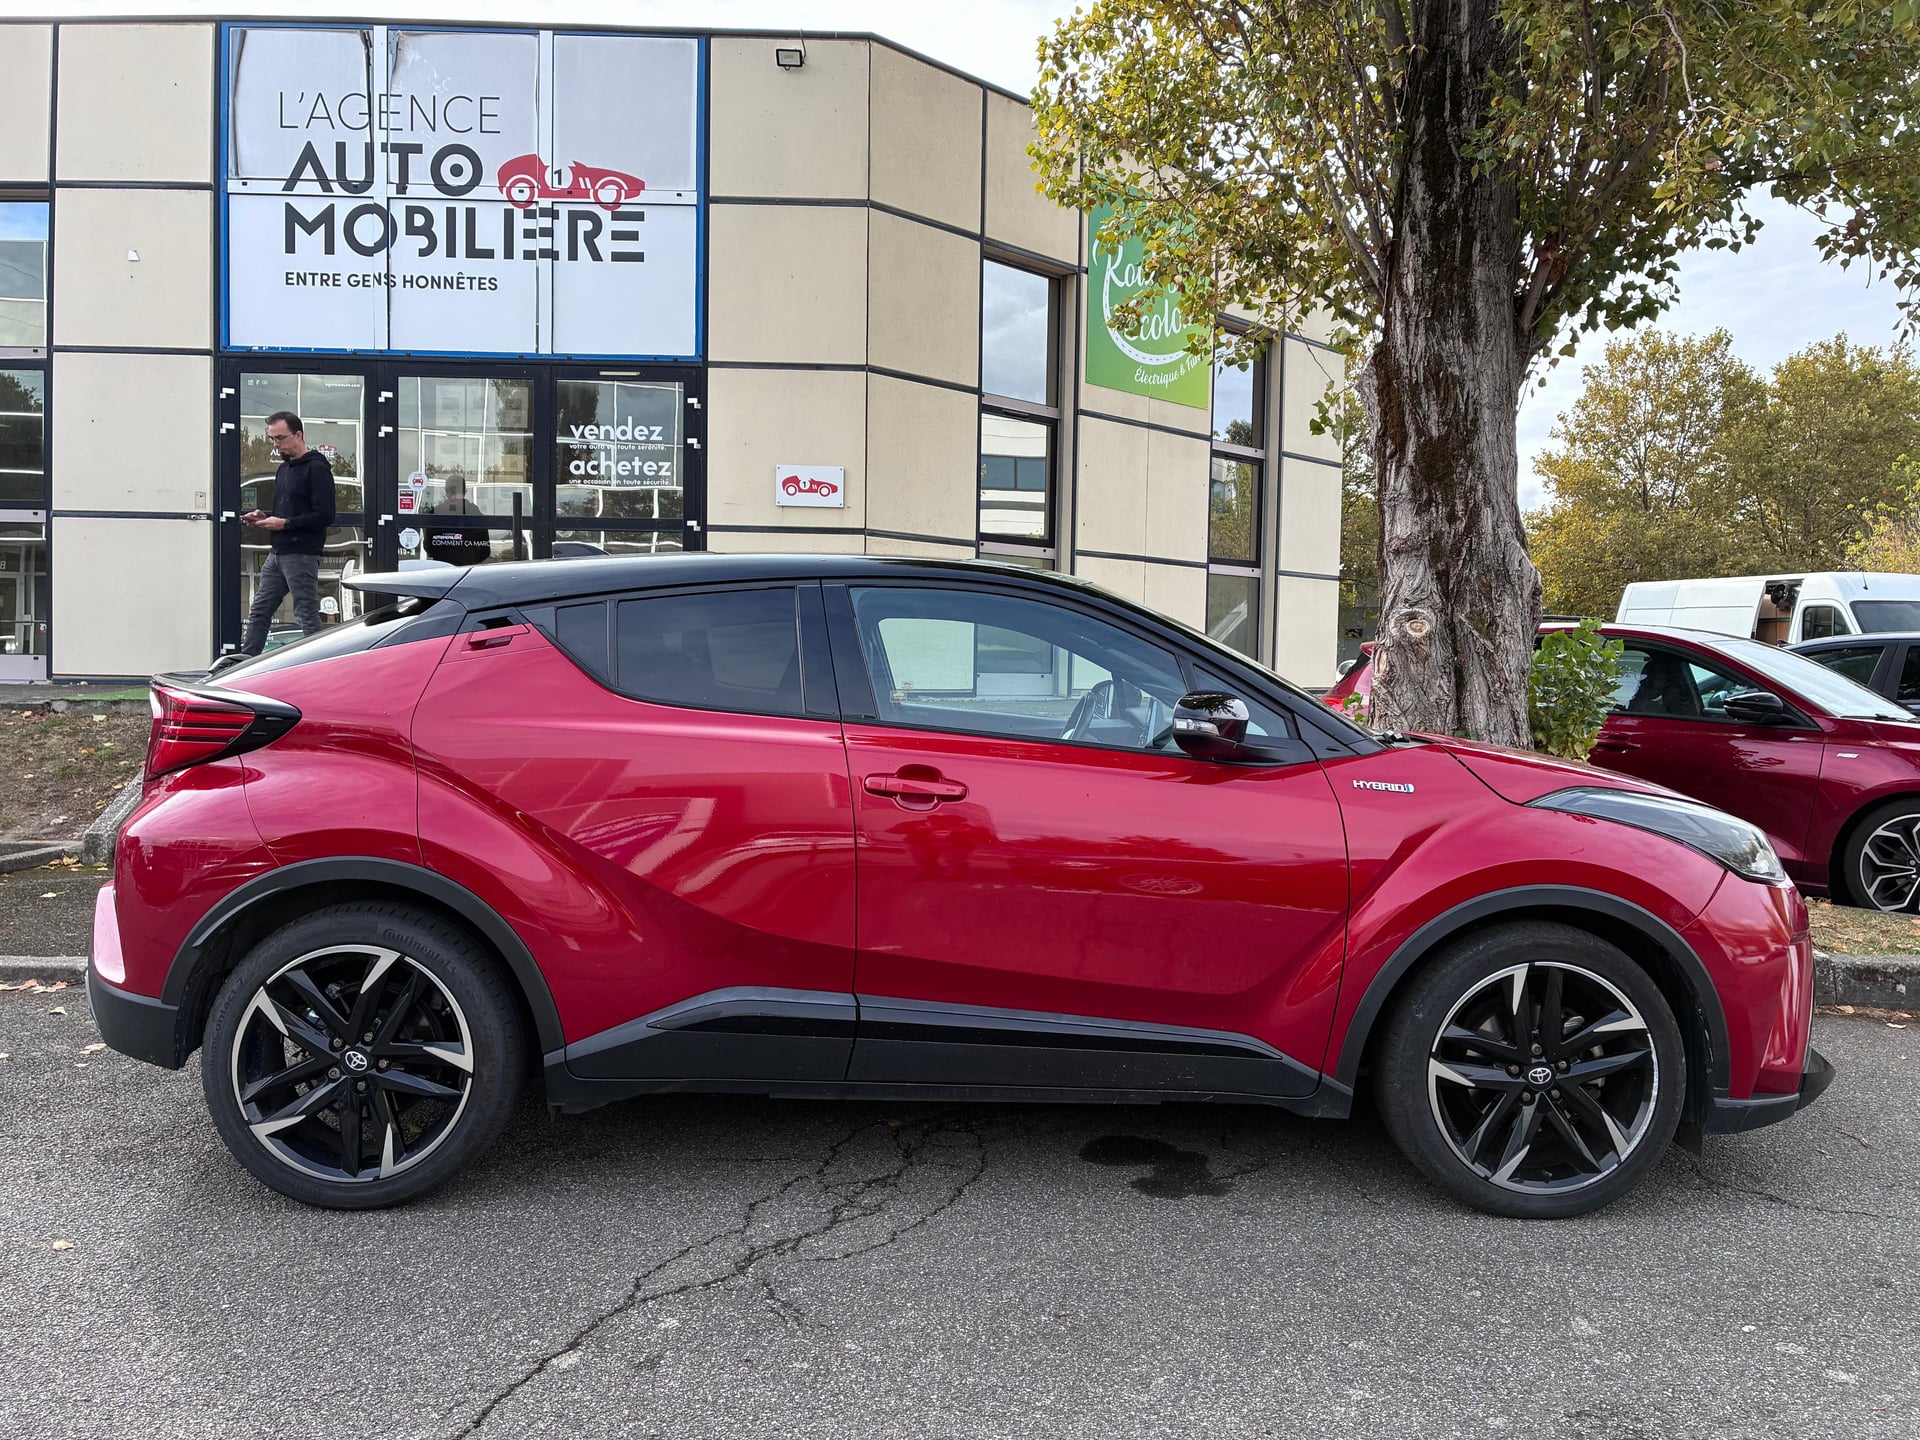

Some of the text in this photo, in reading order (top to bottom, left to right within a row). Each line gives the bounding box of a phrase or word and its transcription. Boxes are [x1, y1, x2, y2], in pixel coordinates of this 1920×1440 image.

[279, 91, 501, 134] L'AGENCE
[281, 140, 483, 197] AUTO
[284, 202, 645, 263] MOBILIERE
[285, 272, 498, 292] ENTRE GENS HONNÊTES
[1134, 366, 1179, 389] Électrique
[1179, 363, 1186, 376] &
[569, 415, 663, 441] vendez
[617, 443, 636, 451] toute
[569, 451, 672, 476] achetez
[1352, 780, 1405, 793] HYBRID
